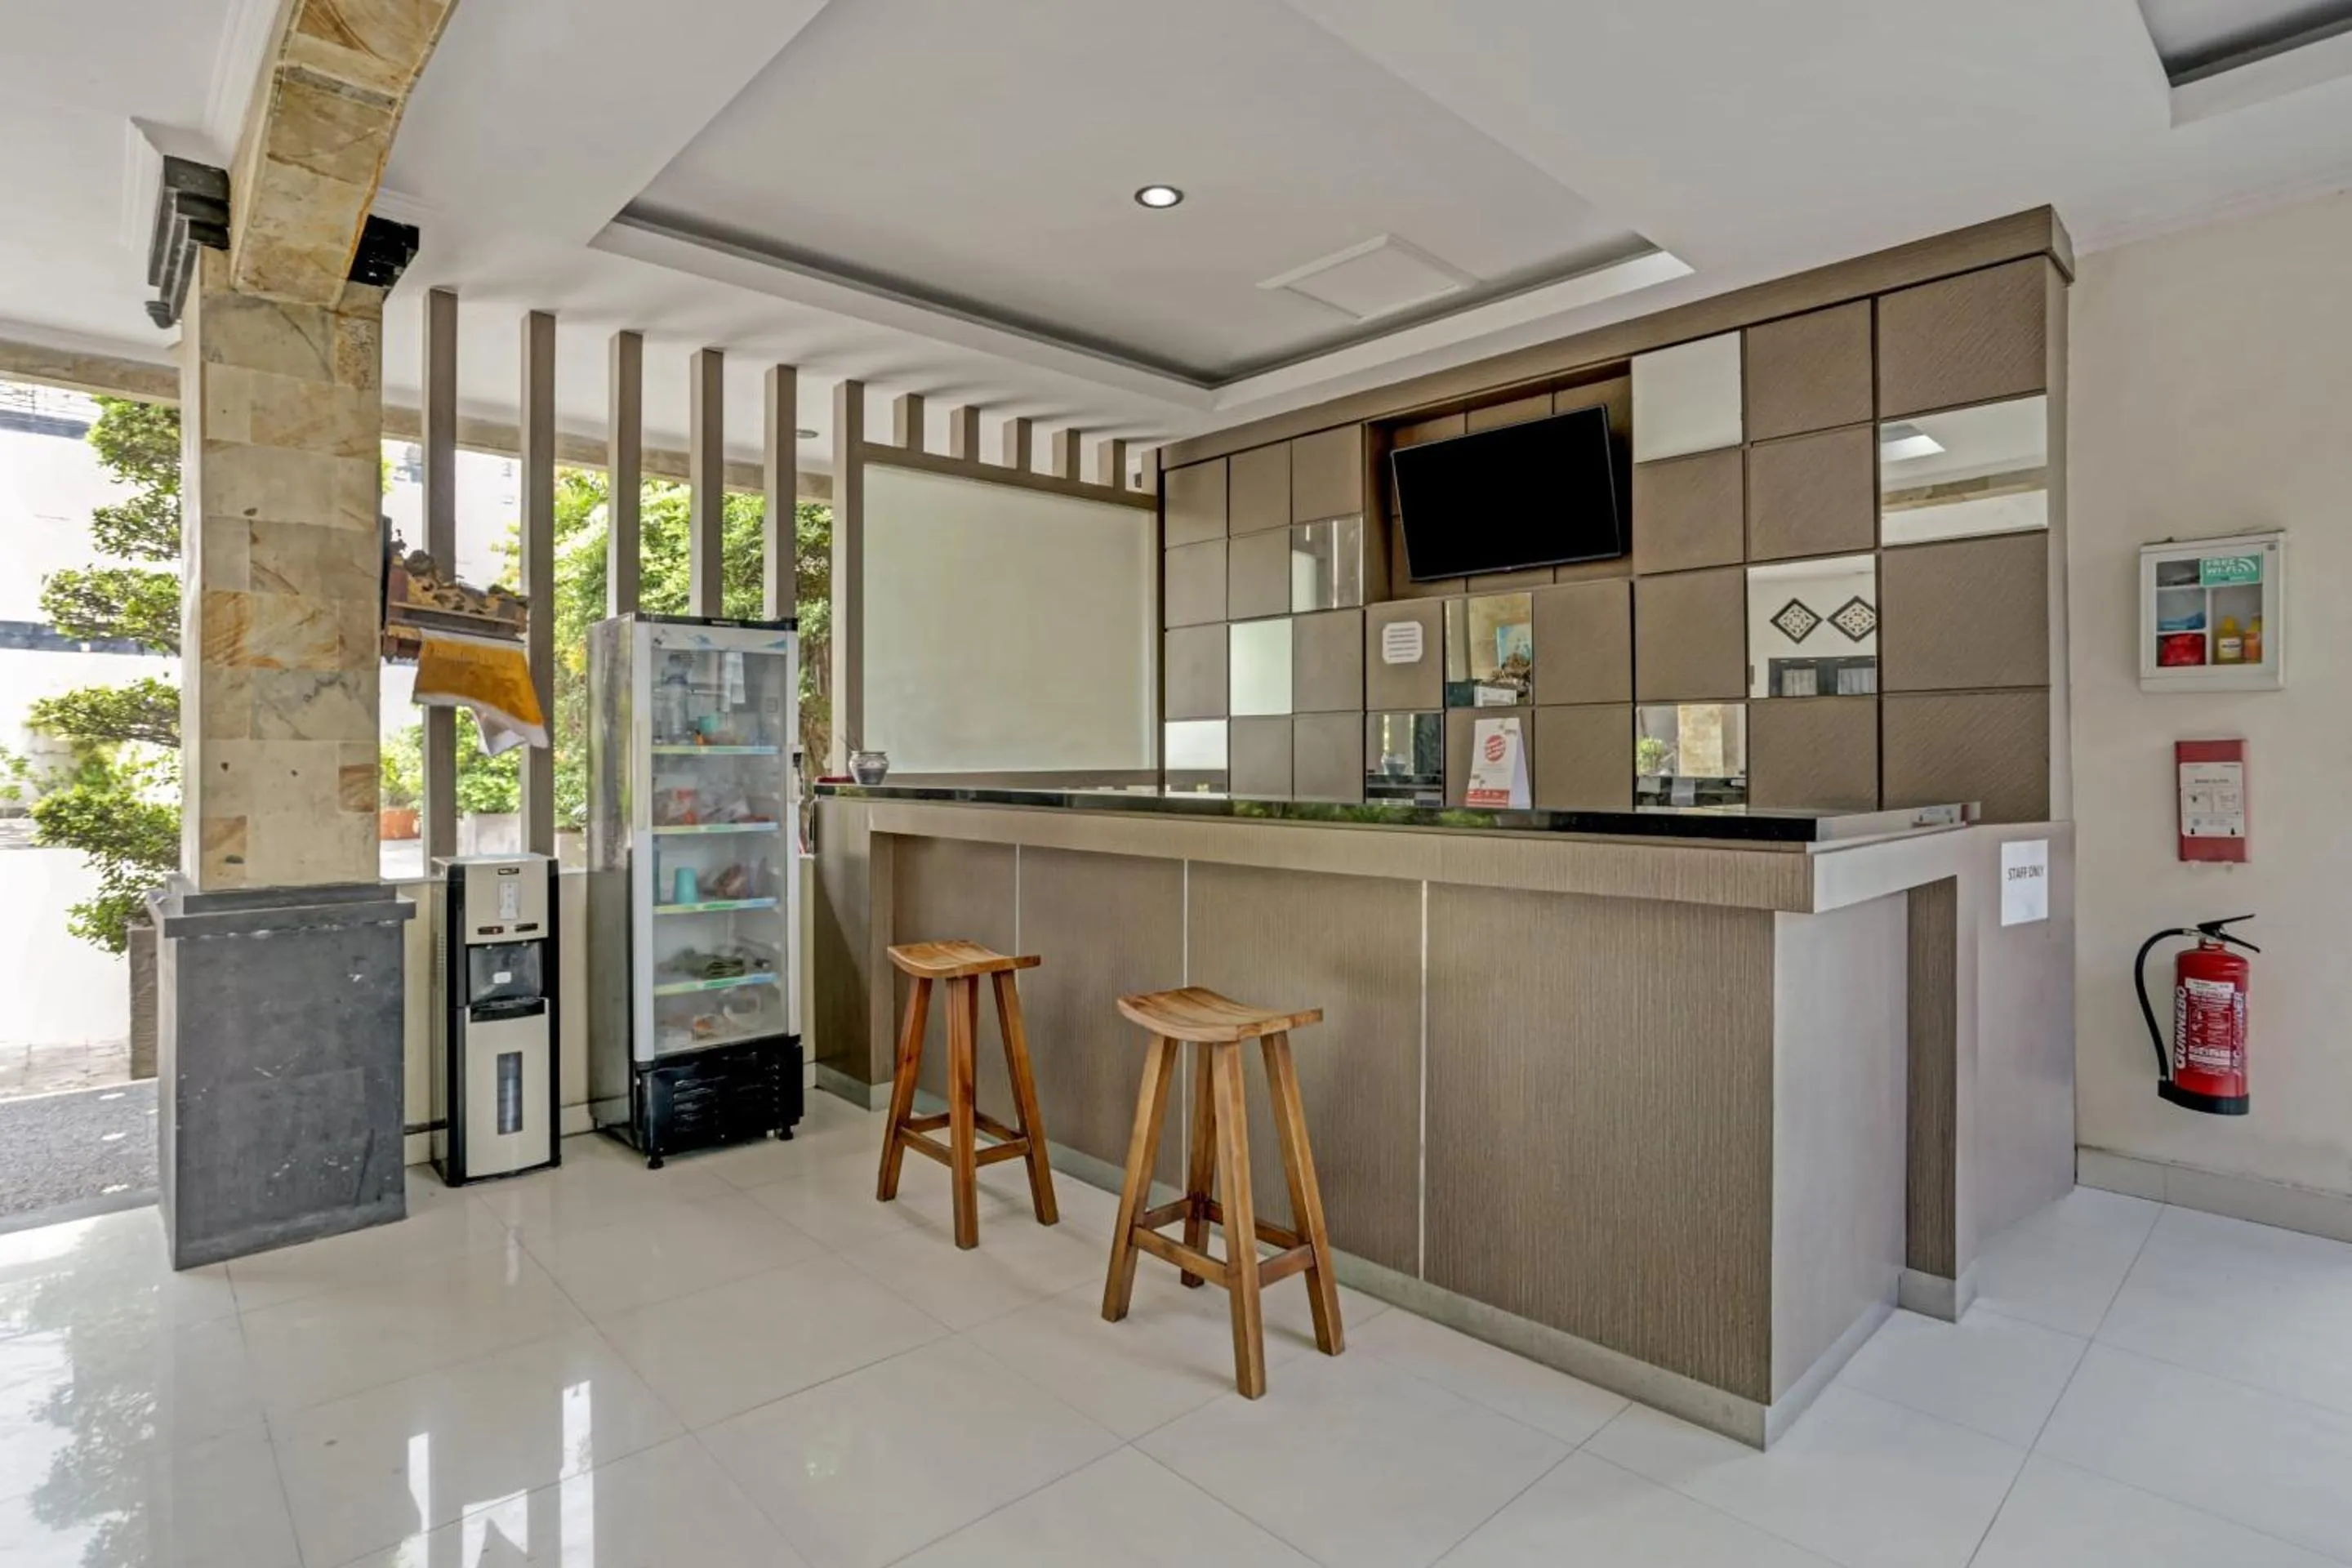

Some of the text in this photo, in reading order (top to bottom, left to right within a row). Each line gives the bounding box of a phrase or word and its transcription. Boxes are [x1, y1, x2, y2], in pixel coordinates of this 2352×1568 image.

[2207, 559, 2235, 568] FREE
[2008, 865, 2044, 881] STAFF ONLY
[2175, 985, 2187, 1069] GUNNEBO
